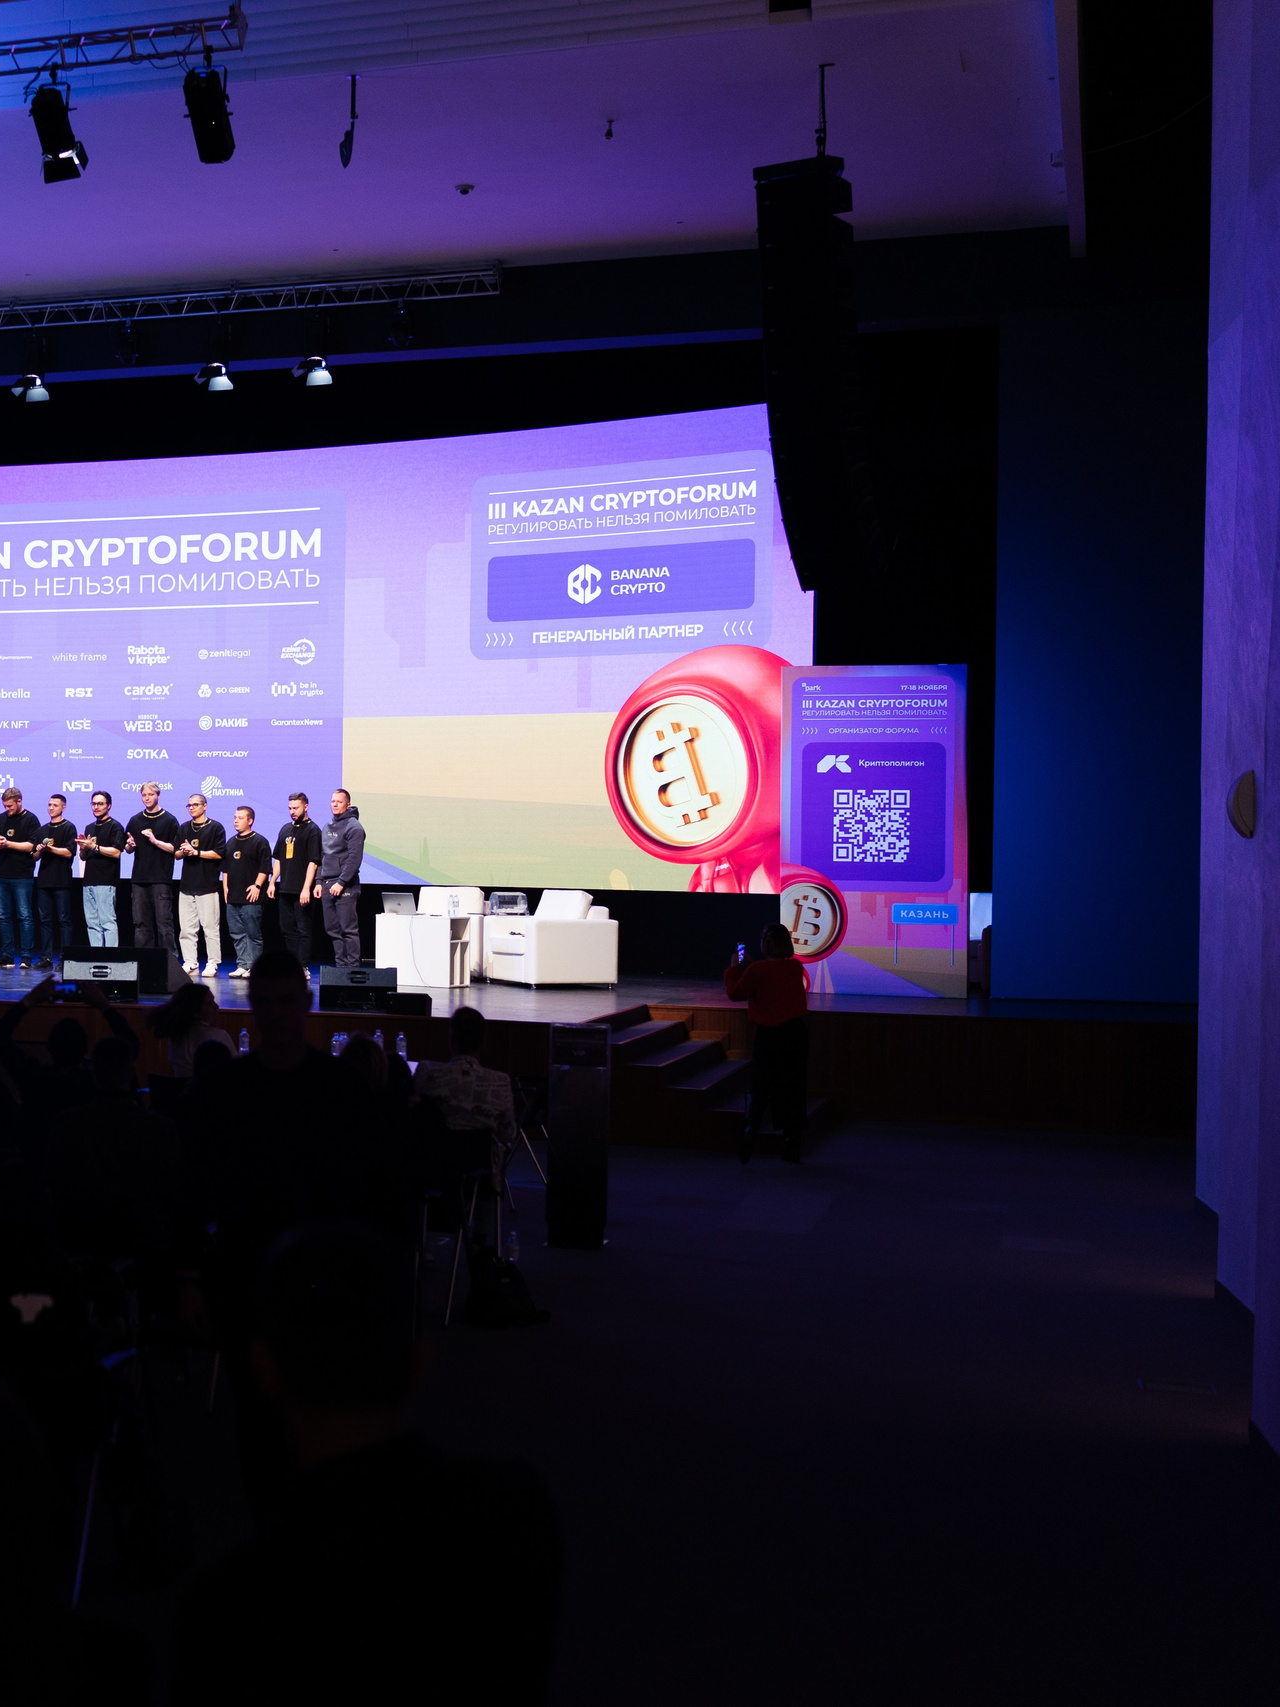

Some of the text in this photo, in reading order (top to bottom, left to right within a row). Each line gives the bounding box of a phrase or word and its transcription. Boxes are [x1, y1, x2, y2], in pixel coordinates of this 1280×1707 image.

[488, 480, 757, 519] III KAZAN CRYPTOFORUM
[488, 504, 756, 536] РЕГУЛИРОВАТЬ НЕЛЬЗЯ ПОМИЛОВАТЬ
[24, 527, 322, 569] CRYPTOFORUM
[610, 566, 670, 581] BANANA
[34, 575, 130, 596] НЕЛЬЗЯ
[140, 569, 319, 593] ПОМИЛОВАТЬ
[610, 581, 665, 596] CRYPTO
[532, 624, 703, 644] ГЕНЕРАЛЬНЫЙ ПАРТНЕР
[127, 645, 165, 655] Rabota
[209, 649, 251, 659] zenitlegal
[52, 653, 107, 662] white frame
[65, 688, 93, 697] RSI
[299, 689, 324, 697] crypto
[802, 699, 948, 708] III KAZAN CRYPTOFORUM
[11, 720, 29, 729] NFT
[124, 720, 173, 732] WEB 3.0
[215, 718, 248, 728] РАКИБ
[126, 749, 169, 759] SOTKA
[859, 759, 925, 769] Криптополигон
[63, 781, 93, 792] NFD
[121, 781, 173, 793] Crypesk
[212, 788, 244, 796] ПАУТИНА
[900, 909, 950, 919] КАЗАНЬ
